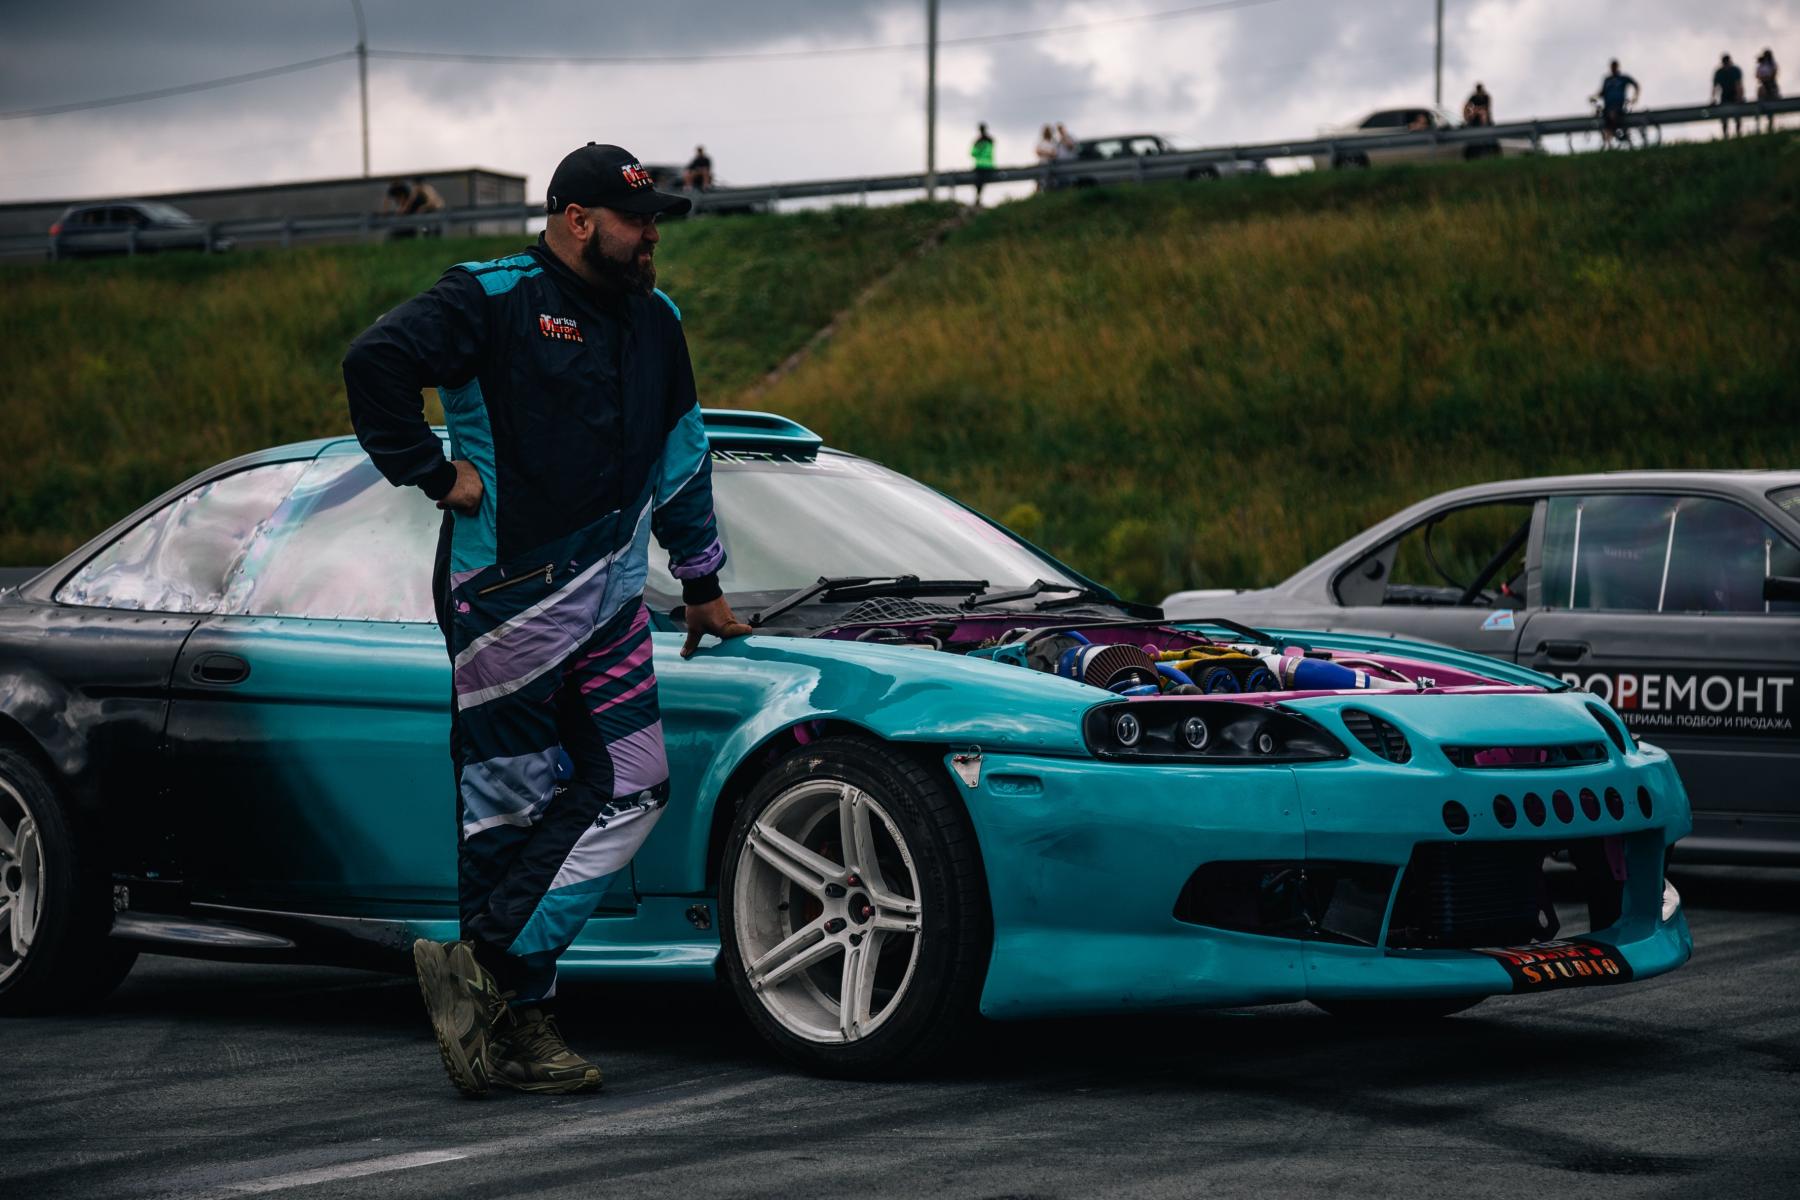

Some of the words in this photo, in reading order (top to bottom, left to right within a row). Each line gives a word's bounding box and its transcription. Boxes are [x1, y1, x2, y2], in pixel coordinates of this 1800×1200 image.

[1545, 672, 1794, 713] РОРЕМОНТ
[1677, 714, 1722, 728] ПОДБОР
[1724, 715, 1733, 728] И
[1735, 715, 1793, 731] ПРОДАЖА
[1521, 958, 1620, 984] STUDIO
